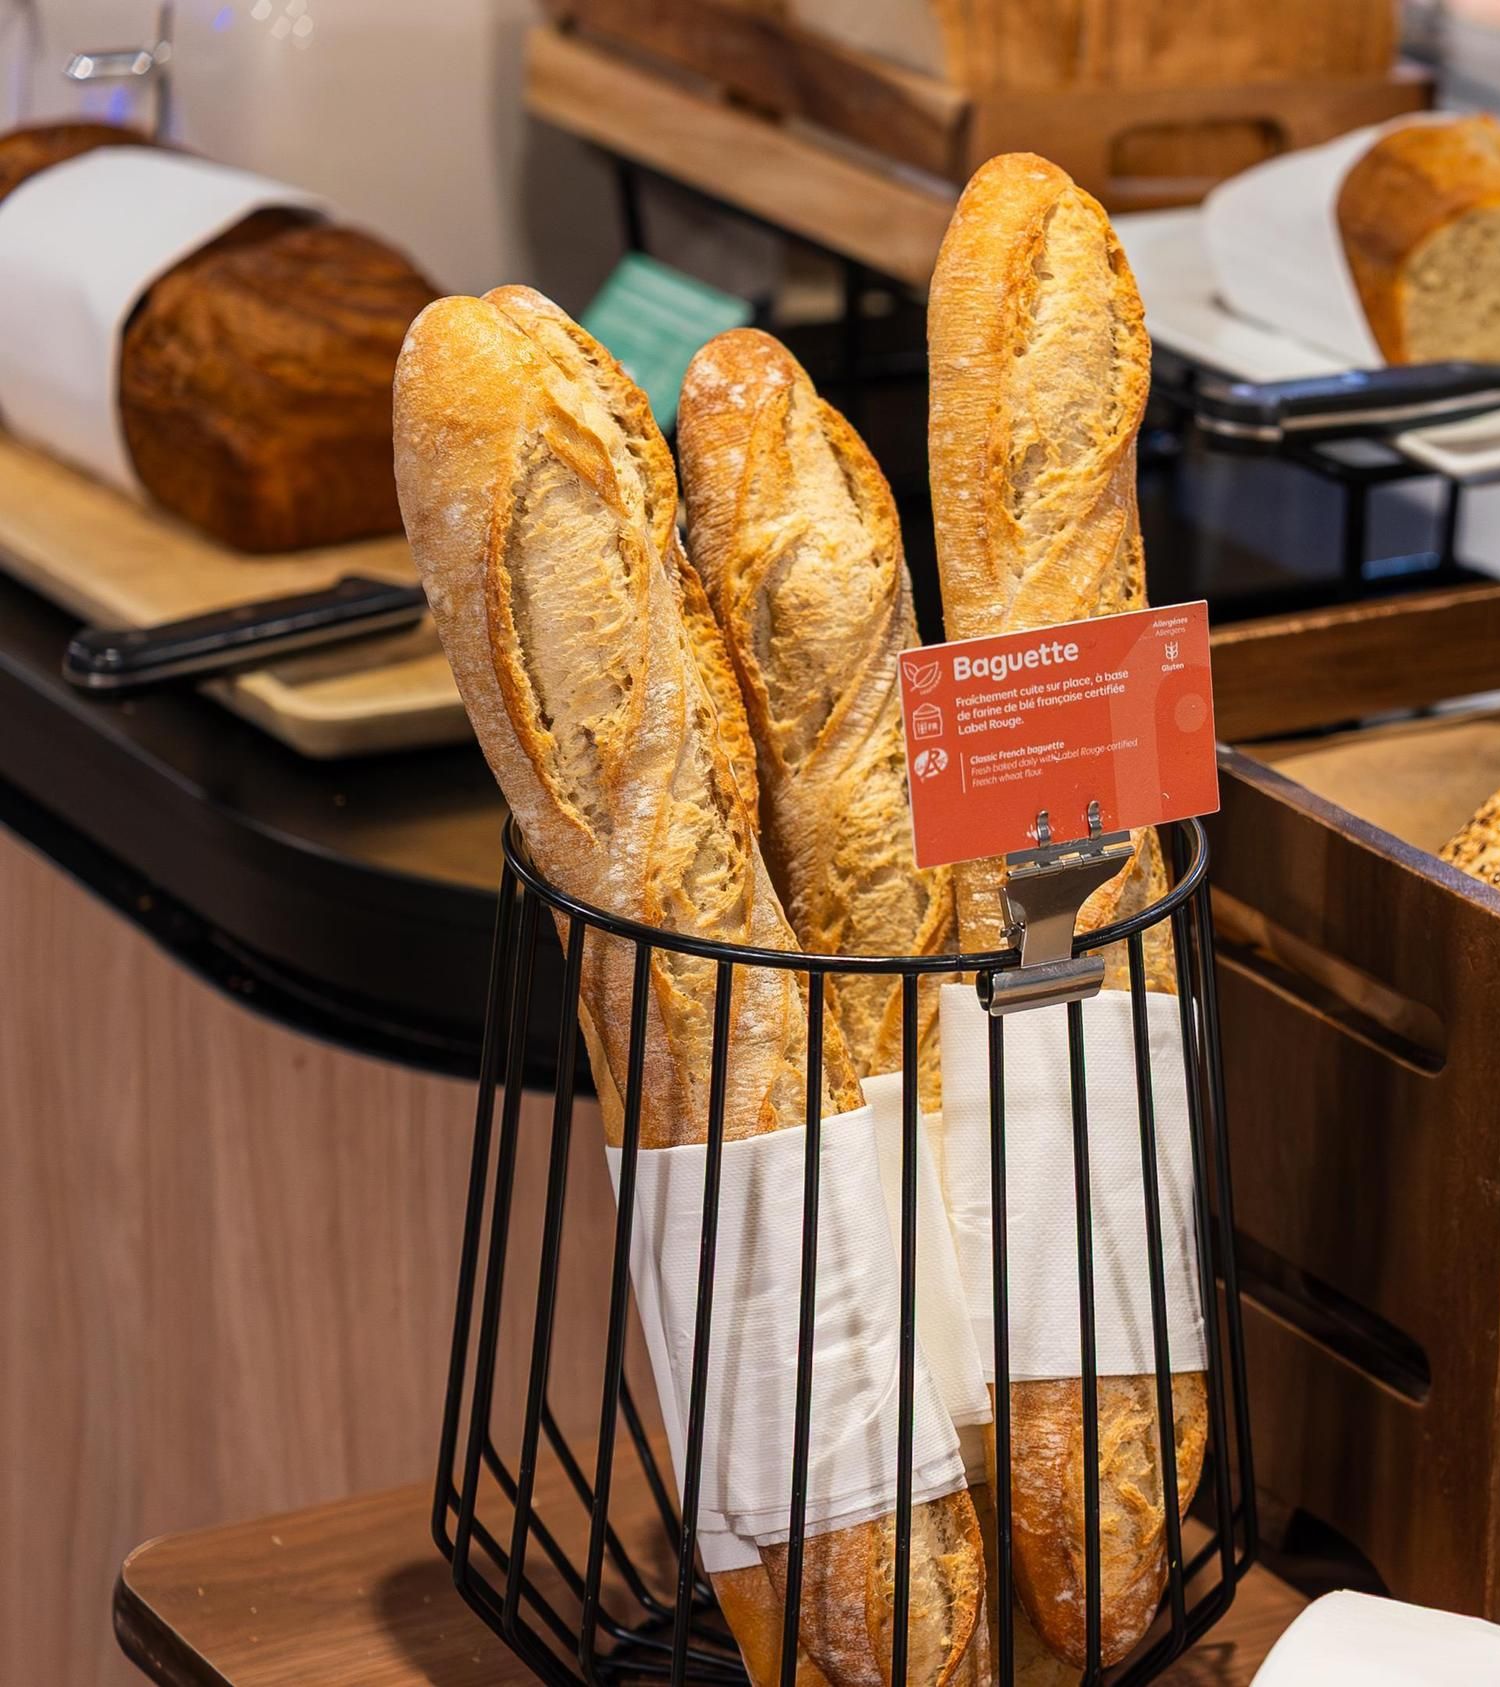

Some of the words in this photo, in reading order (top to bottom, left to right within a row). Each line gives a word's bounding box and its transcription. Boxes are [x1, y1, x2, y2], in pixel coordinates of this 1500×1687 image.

[953, 641, 1079, 681] Baguette
[1161, 663, 1185, 672] Gluten
[1020, 684, 1045, 697] cuite
[1046, 681, 1062, 692] sur
[1062, 676, 1094, 691] place,
[1094, 673, 1103, 684] à
[1104, 669, 1129, 682] base
[957, 708, 971, 722] de
[972, 703, 1001, 719] farine
[1003, 700, 1018, 713] de
[1019, 697, 1035, 711] blé
[1036, 689, 1083, 707] française
[1084, 683, 1126, 699] certifiée
[957, 721, 988, 736] Label
[989, 715, 1025, 731] Rouge.
[970, 753, 998, 765] Classic
[998, 747, 1026, 760] French
[1027, 741, 1065, 756] baguette
[992, 759, 1018, 772] baked
[1018, 756, 1038, 769] daily
[1057, 749, 1080, 761] Label
[1080, 746, 1105, 758] Rouge
[1105, 738, 1138, 751] certified
[972, 776, 998, 788] French
[998, 771, 1024, 784] wheat
